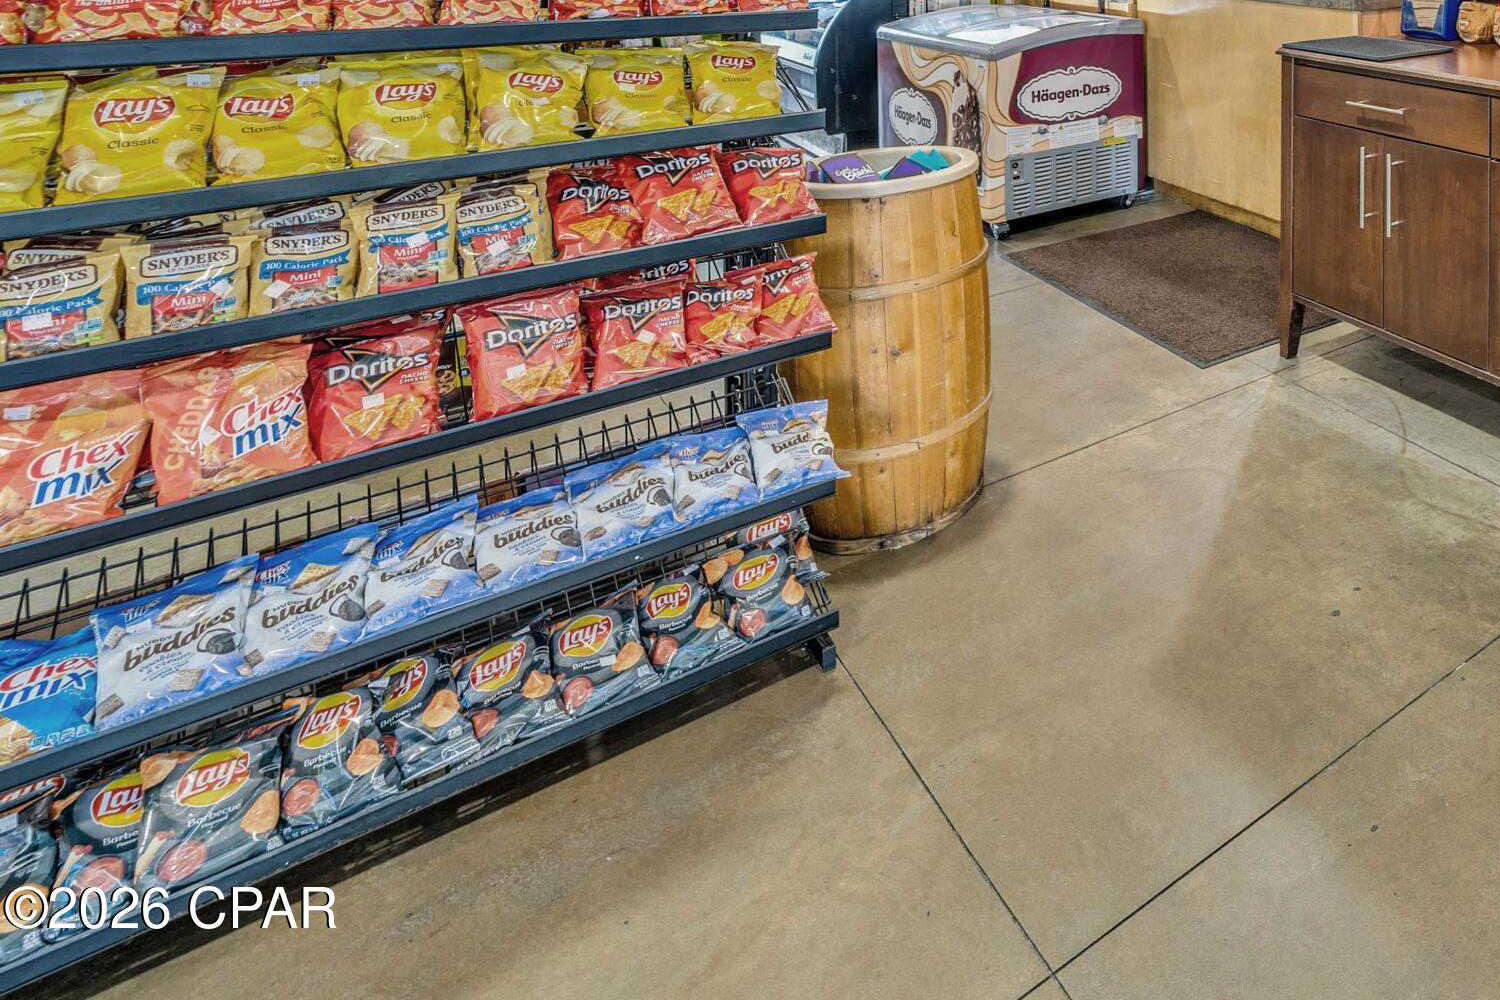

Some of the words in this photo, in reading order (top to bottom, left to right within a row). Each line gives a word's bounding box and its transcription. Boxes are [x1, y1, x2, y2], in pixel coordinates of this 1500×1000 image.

[713, 55, 755, 71] Lay's
[511, 75, 563, 94] Lay's
[615, 70, 662, 87] Lay's
[380, 83, 435, 103] Lay's
[99, 97, 173, 123] Lay's
[228, 96, 293, 118] Lay's
[390, 112, 432, 123] Classic
[107, 136, 160, 149] Classic
[636, 153, 710, 179] Doritos
[733, 154, 800, 173] Doritos
[561, 184, 630, 201] Doritos
[372, 208, 438, 225] SNYDER'S
[460, 198, 519, 217] SNYDER'S
[272, 235, 341, 248] SNYDER'S
[394, 248, 422, 258] Mini
[147, 250, 229, 270] SNYDER'S
[323, 256, 343, 265] Pack
[289, 272, 321, 282] Mini
[66, 297, 95, 310] Pack
[170, 295, 207, 308] Mini
[604, 296, 682, 319] Doritos
[688, 288, 754, 304] Doritos
[486, 314, 577, 350] Doritos
[329, 353, 428, 387] Doritos
[400, 374, 430, 384] CHEESE
[401, 371, 428, 380] NACHO
[224, 385, 302, 435] Chex
[236, 403, 302, 456] mix
[30, 433, 137, 480] Chex
[689, 455, 747, 481] buddies
[35, 459, 122, 506] mix
[596, 478, 664, 513] buddies
[494, 514, 573, 548] buddies
[749, 515, 790, 541] Lay's
[381, 537, 464, 582] buddies
[736, 556, 777, 587] Lay's
[262, 576, 358, 627] buddies
[649, 586, 690, 617] Lay's
[561, 618, 611, 648] Lay's
[659, 614, 694, 630] Barbecue
[124, 607, 236, 671] buddies
[136, 635, 173, 649] MUDDY
[0, 657, 97, 691] Chex
[475, 645, 524, 686] Lay's
[306, 700, 360, 732] Lay's
[380, 702, 422, 727] Barbecue
[179, 757, 248, 800] Lay's
[188, 803, 242, 827] Barbecue
[103, 831, 138, 847] Barbe
